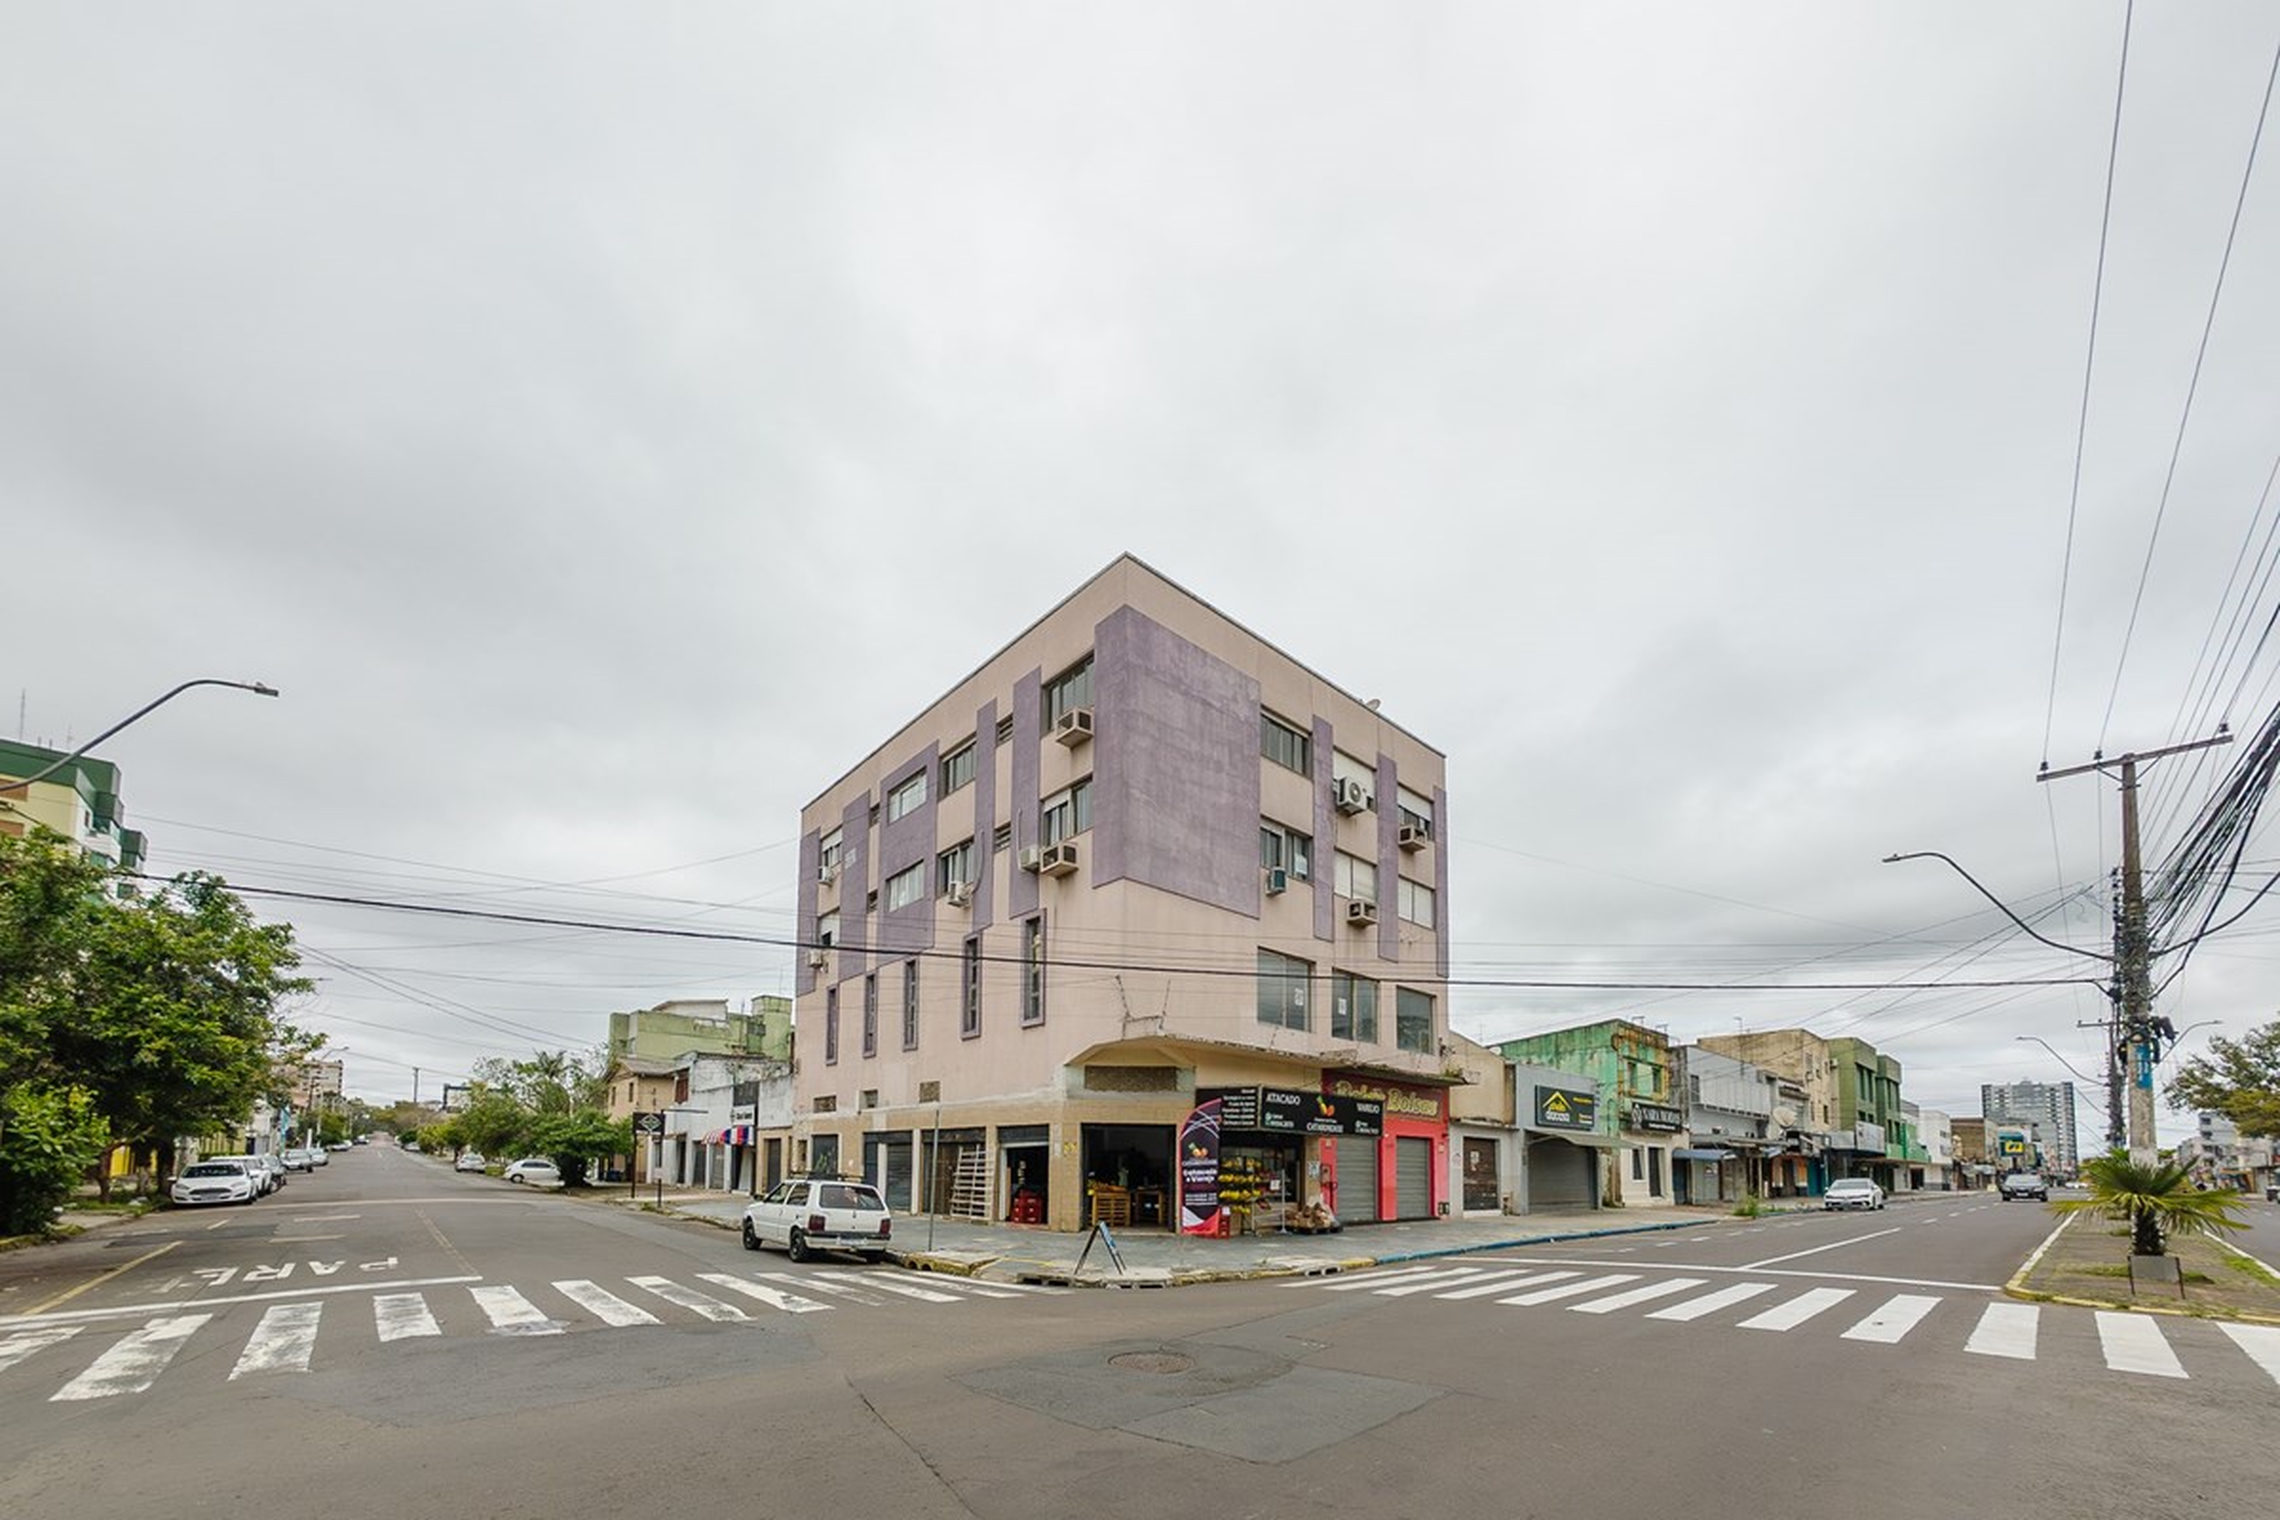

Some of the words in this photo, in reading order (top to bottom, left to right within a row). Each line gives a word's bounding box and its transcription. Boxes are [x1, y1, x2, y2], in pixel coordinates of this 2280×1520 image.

[1266, 1092, 1300, 1106] ATACADO
[1356, 1102, 1380, 1115] VAREJO
[192, 1257, 399, 1287] PARE
